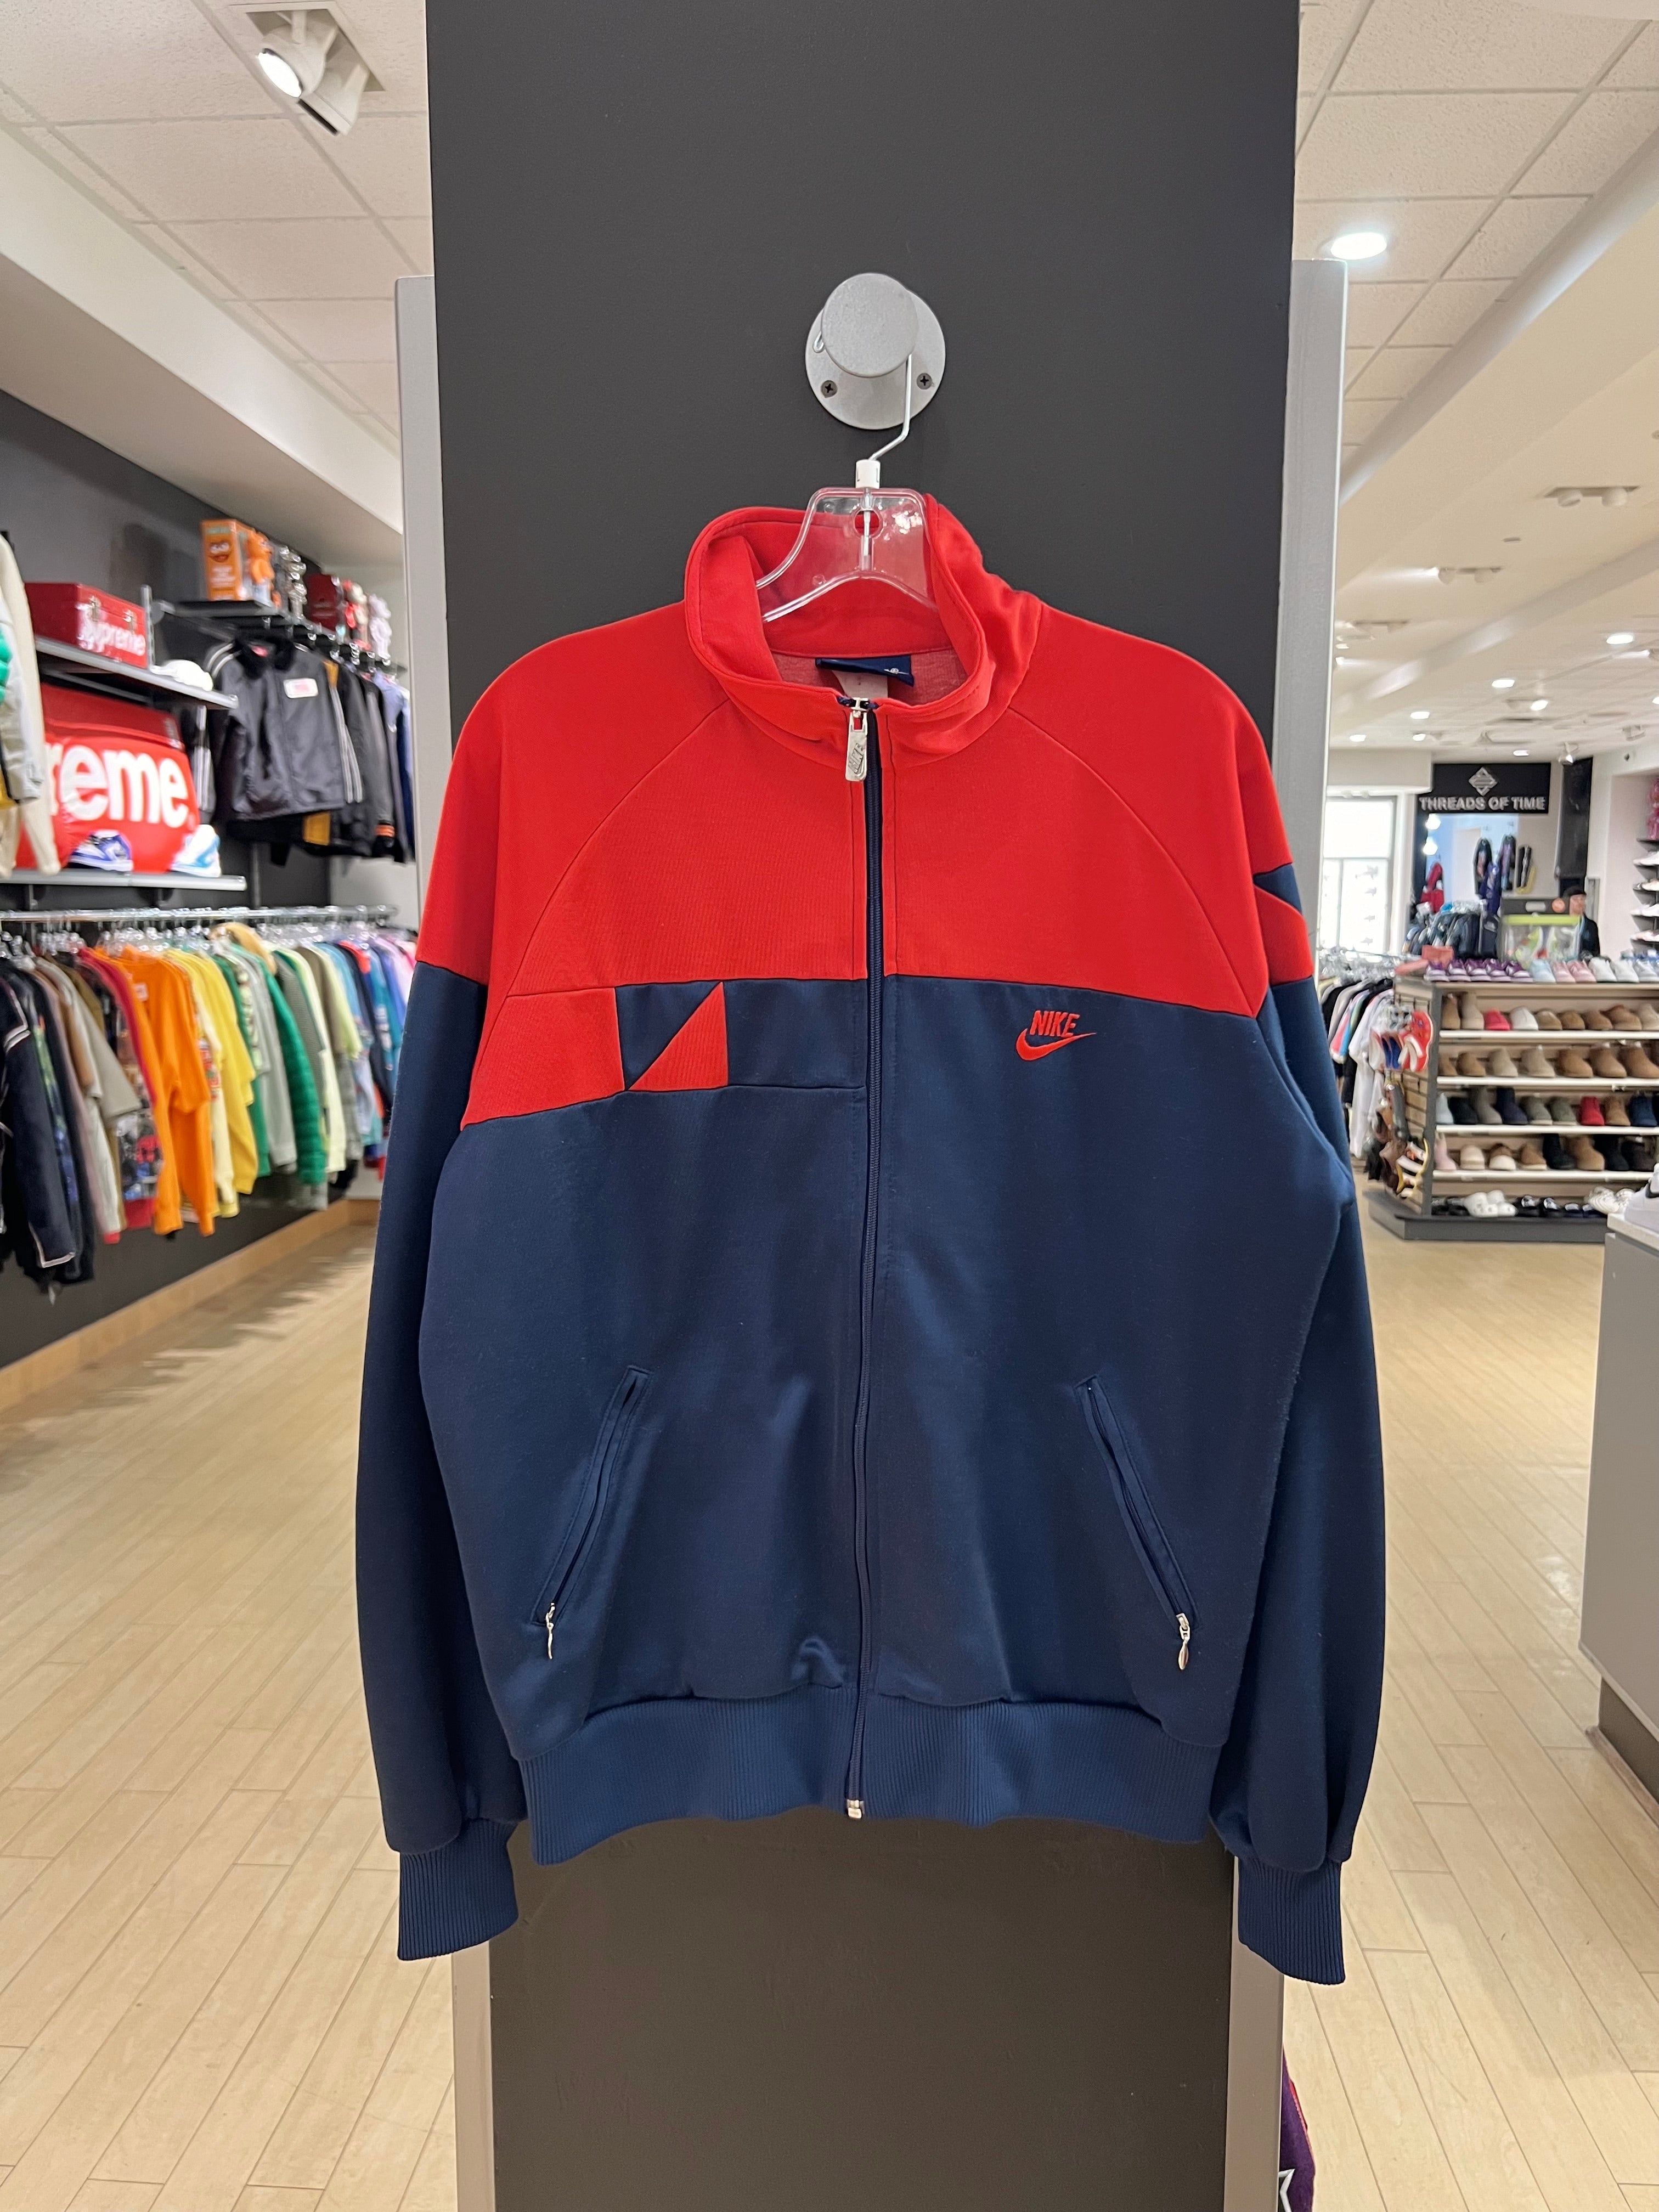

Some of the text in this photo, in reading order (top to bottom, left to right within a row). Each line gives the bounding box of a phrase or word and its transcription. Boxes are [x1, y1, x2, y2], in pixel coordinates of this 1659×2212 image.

[45, 743, 188, 828] reme
[1419, 797, 1545, 810] THREADS OF TIME
[1029, 1010, 1080, 1038] NIKE
